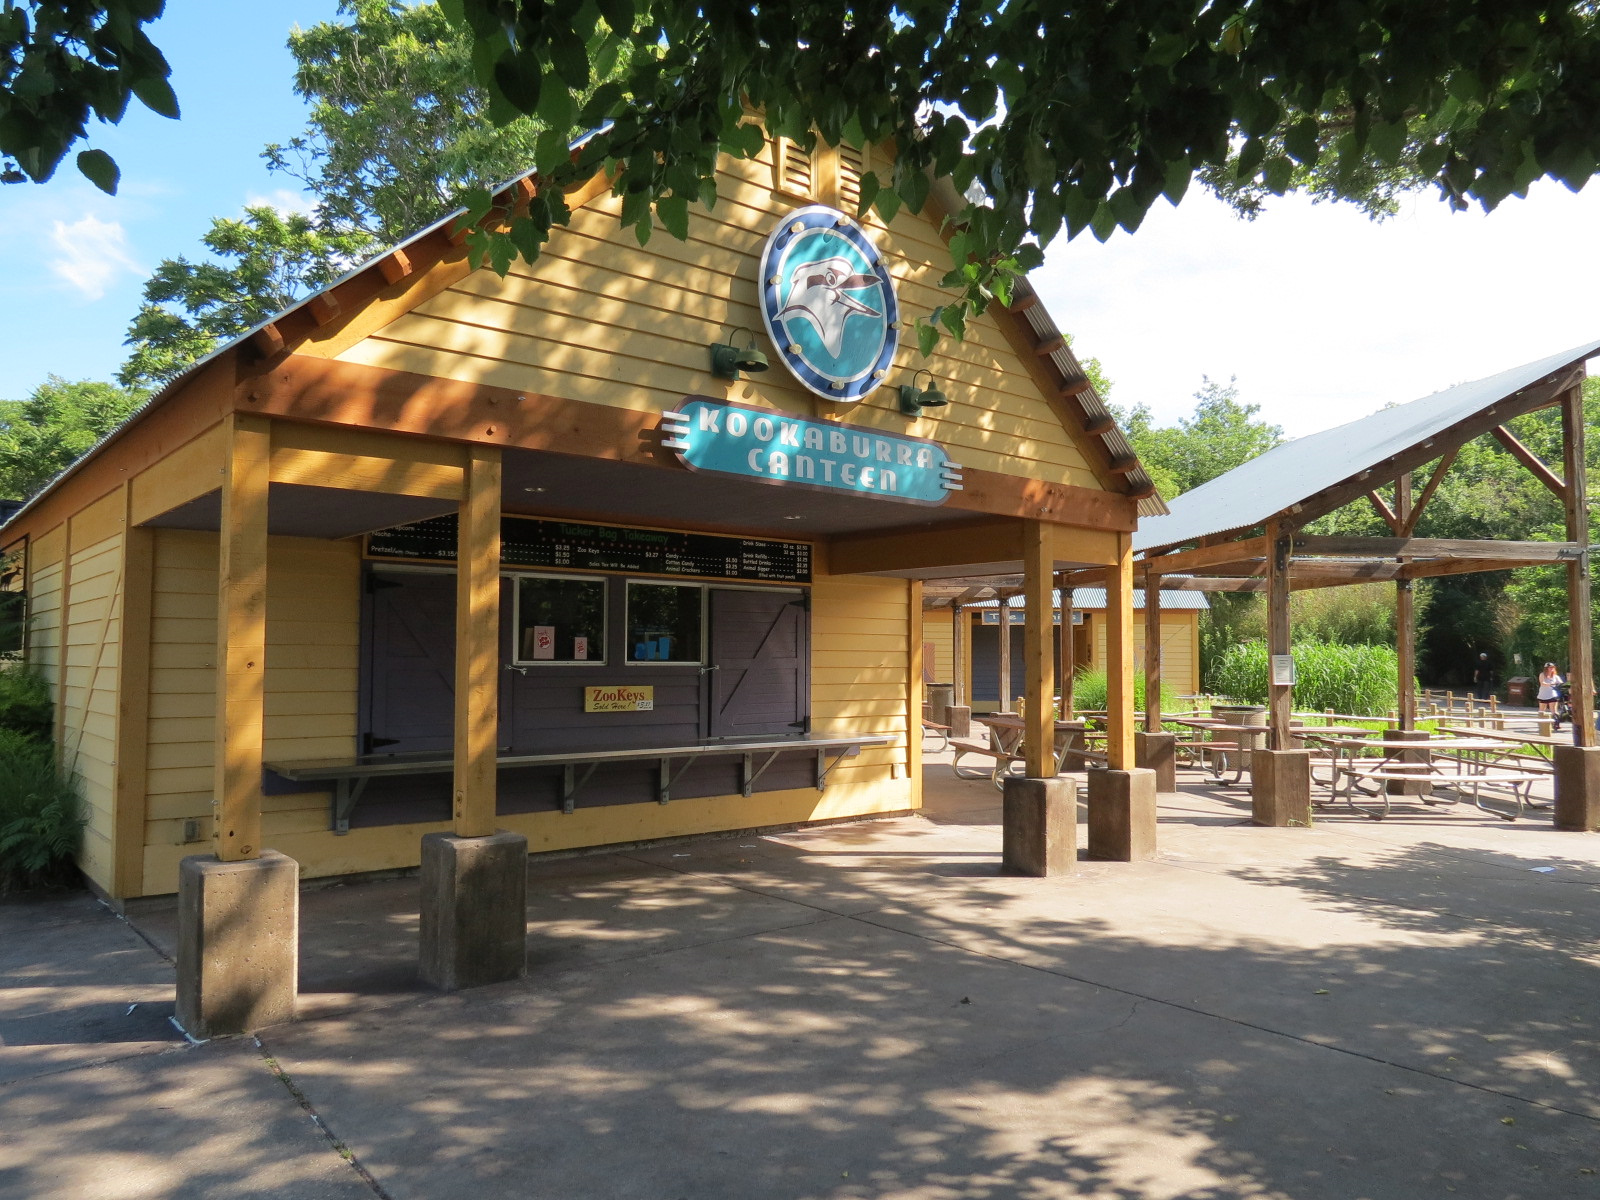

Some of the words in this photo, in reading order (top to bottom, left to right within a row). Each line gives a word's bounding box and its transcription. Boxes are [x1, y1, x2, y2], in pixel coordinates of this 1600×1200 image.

[699, 406, 934, 469] KOOKABURRA
[747, 448, 898, 492] CANTEEN
[559, 524, 594, 536] Tucker
[599, 527, 617, 541] Bag
[623, 529, 669, 546] Takeaway
[593, 688, 645, 704] ZooKeys
[611, 702, 631, 710] Here!
